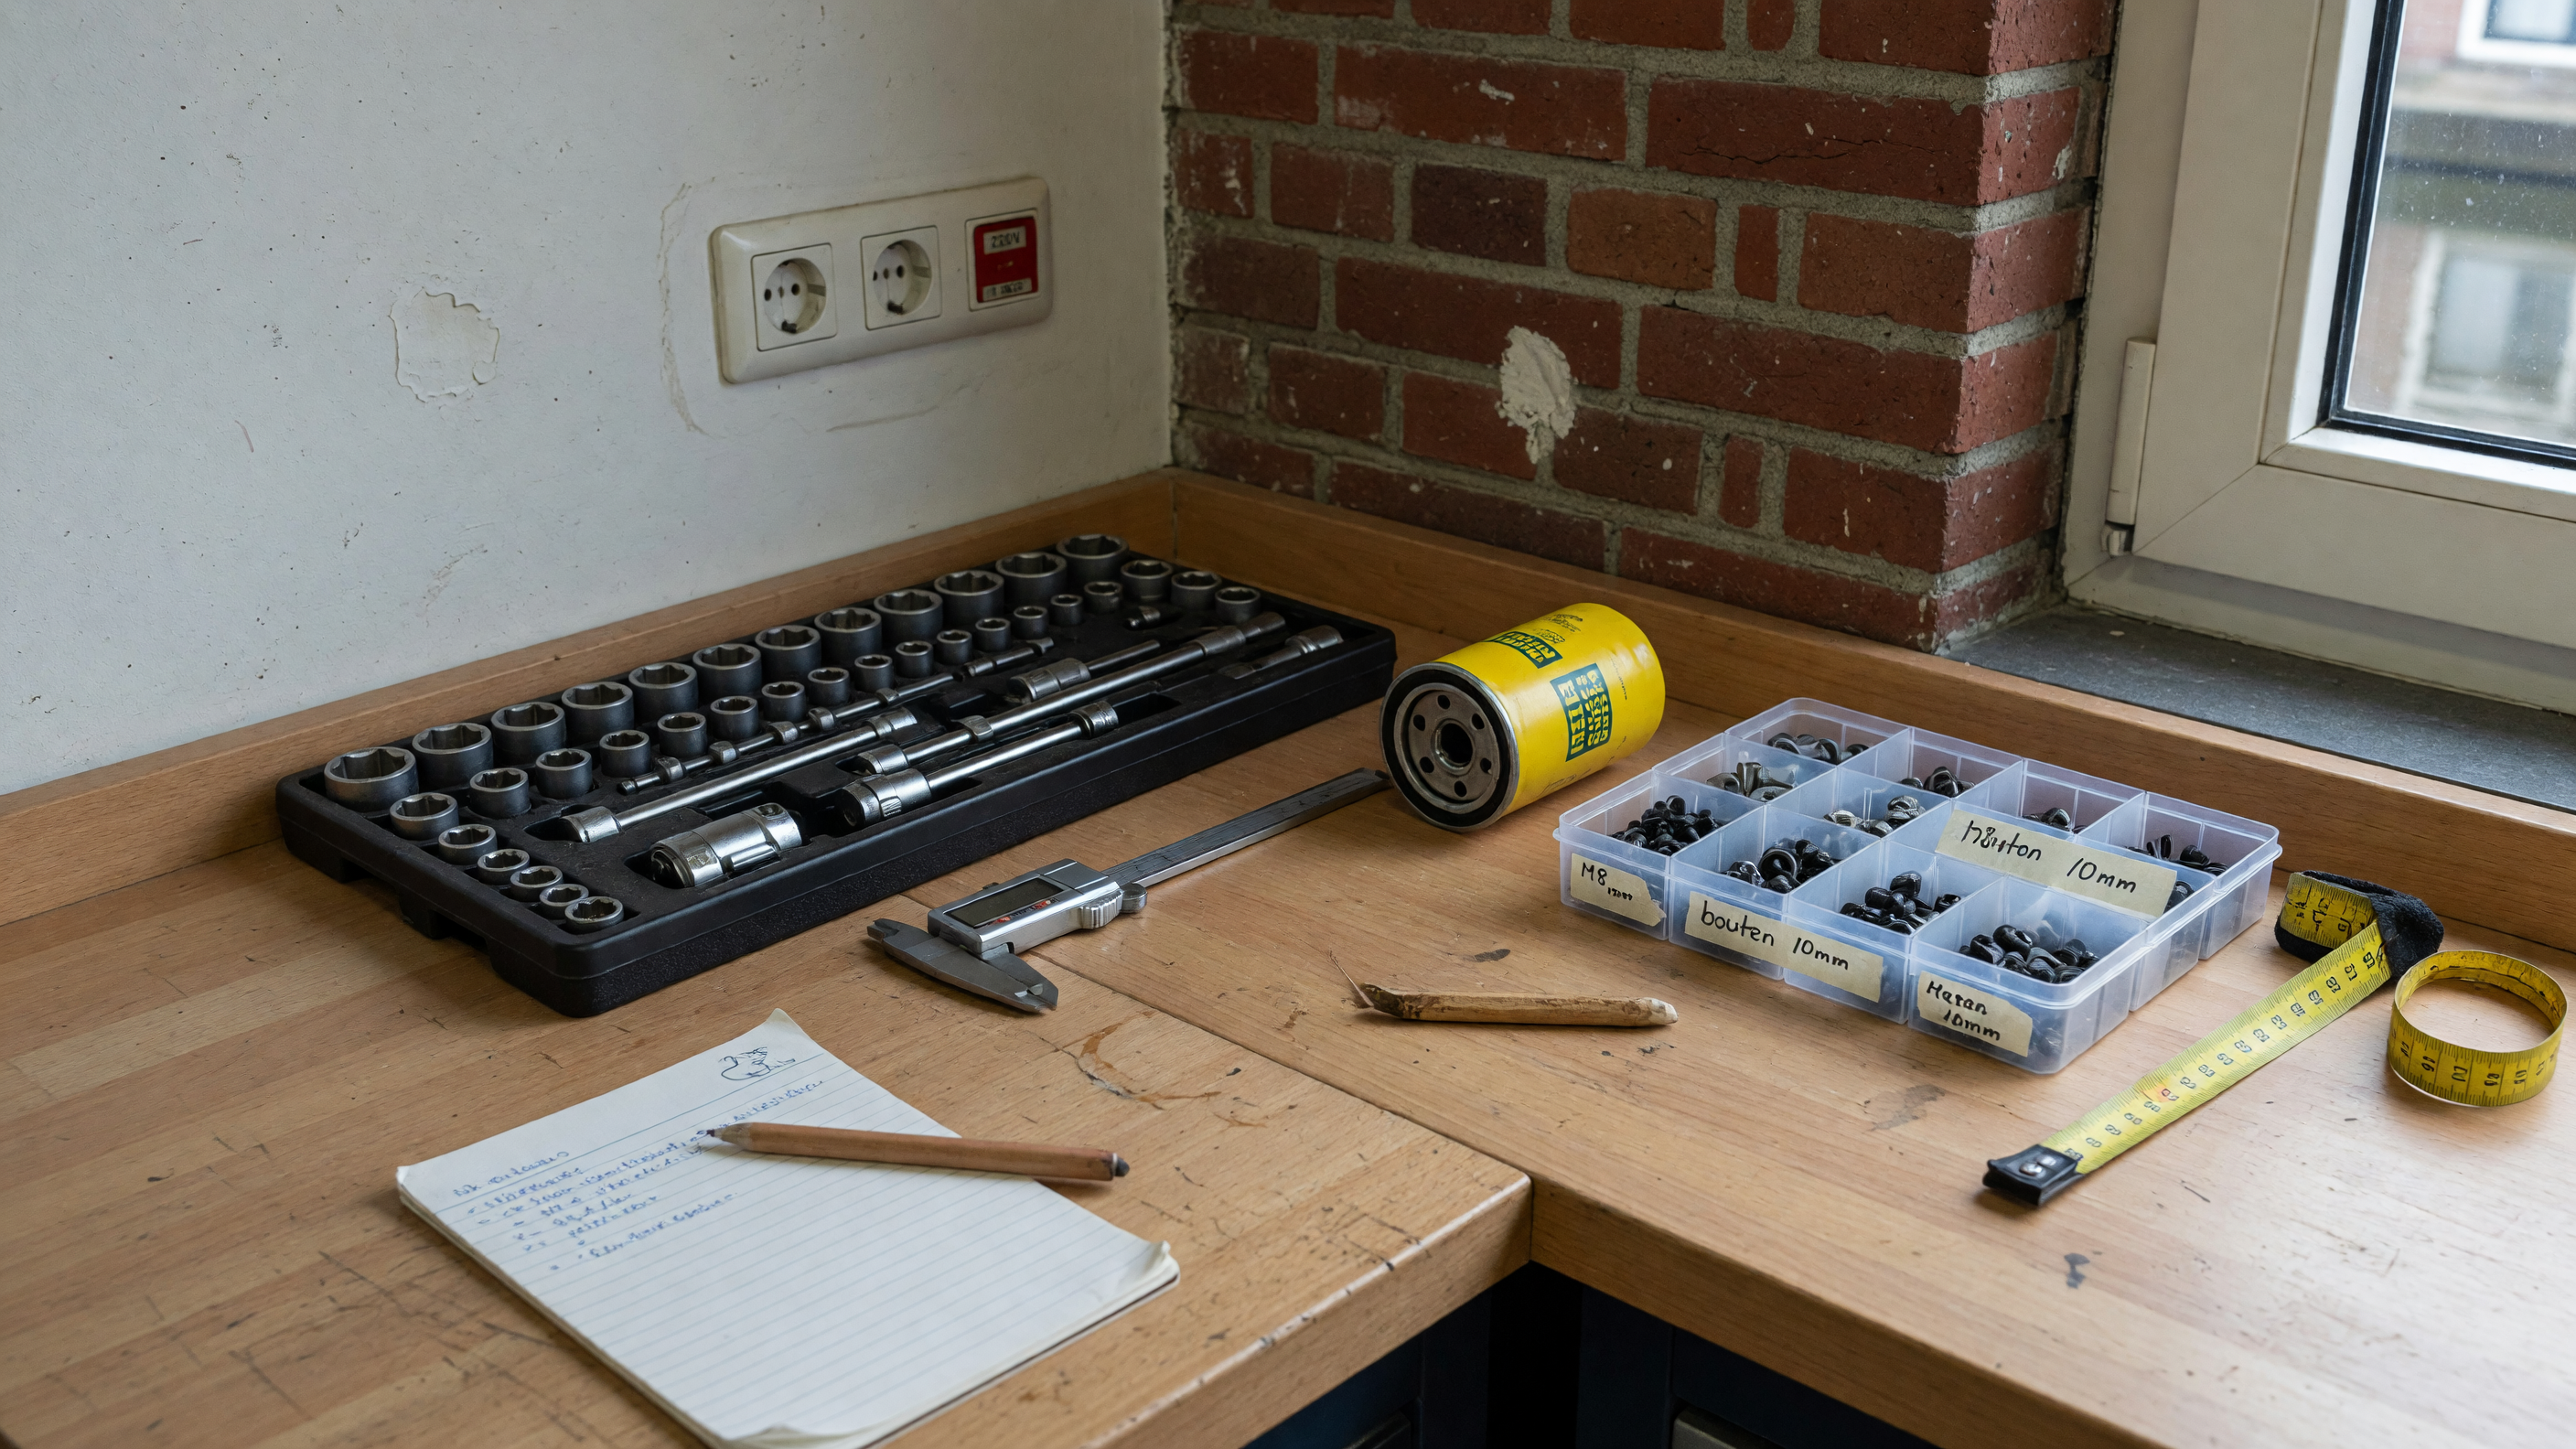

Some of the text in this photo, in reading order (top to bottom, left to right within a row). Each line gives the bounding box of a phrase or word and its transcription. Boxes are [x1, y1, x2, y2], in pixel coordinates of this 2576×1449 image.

[1581, 861, 1607, 886] M8
[2066, 857, 2137, 893] 10mm
[1701, 900, 1849, 970] bouten 10mm
[1942, 1009, 2001, 1041] 10mm
